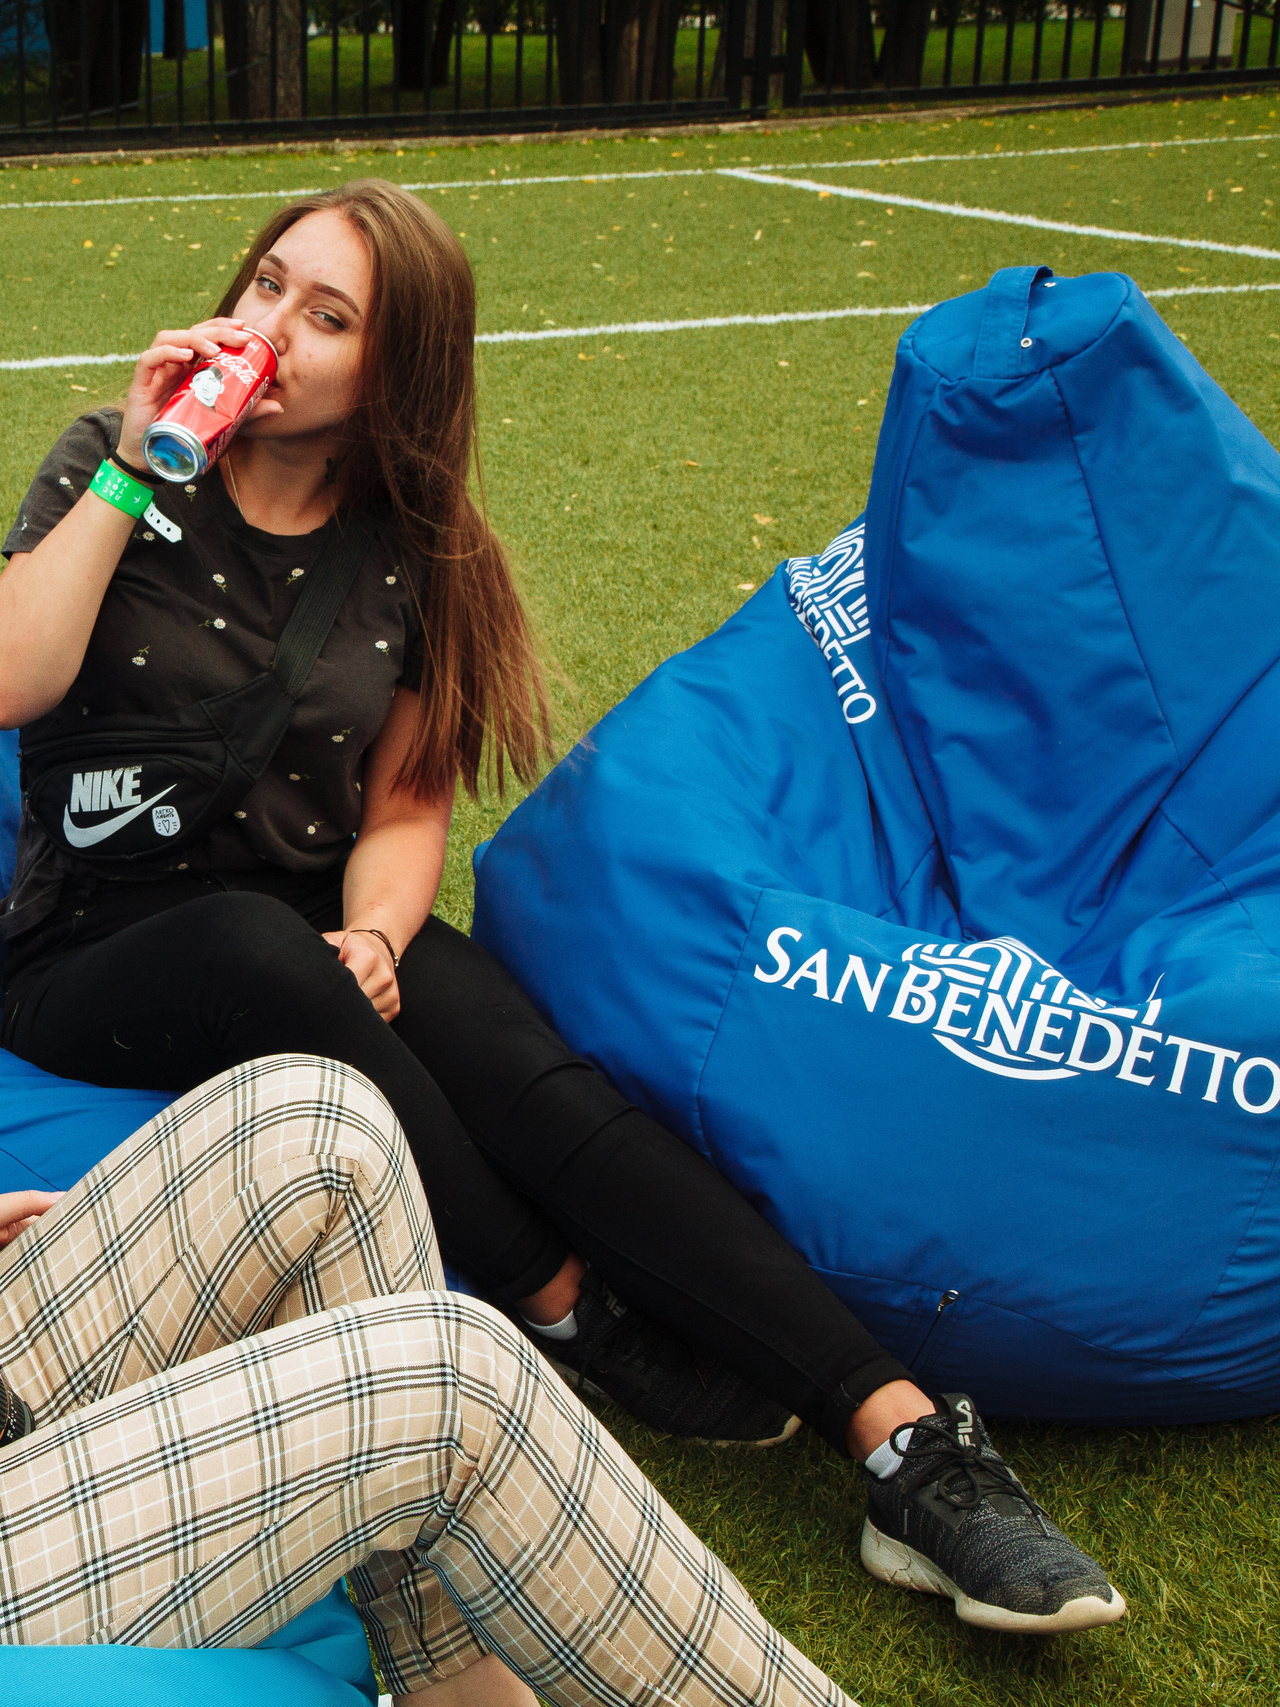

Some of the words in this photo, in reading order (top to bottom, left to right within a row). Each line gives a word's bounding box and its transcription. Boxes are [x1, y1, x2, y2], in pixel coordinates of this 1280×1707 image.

[70, 765, 142, 813] NIKE
[754, 926, 892, 1012] SAN
[888, 961, 1280, 1114] BENEDETTO
[956, 1399, 977, 1447] FILA
